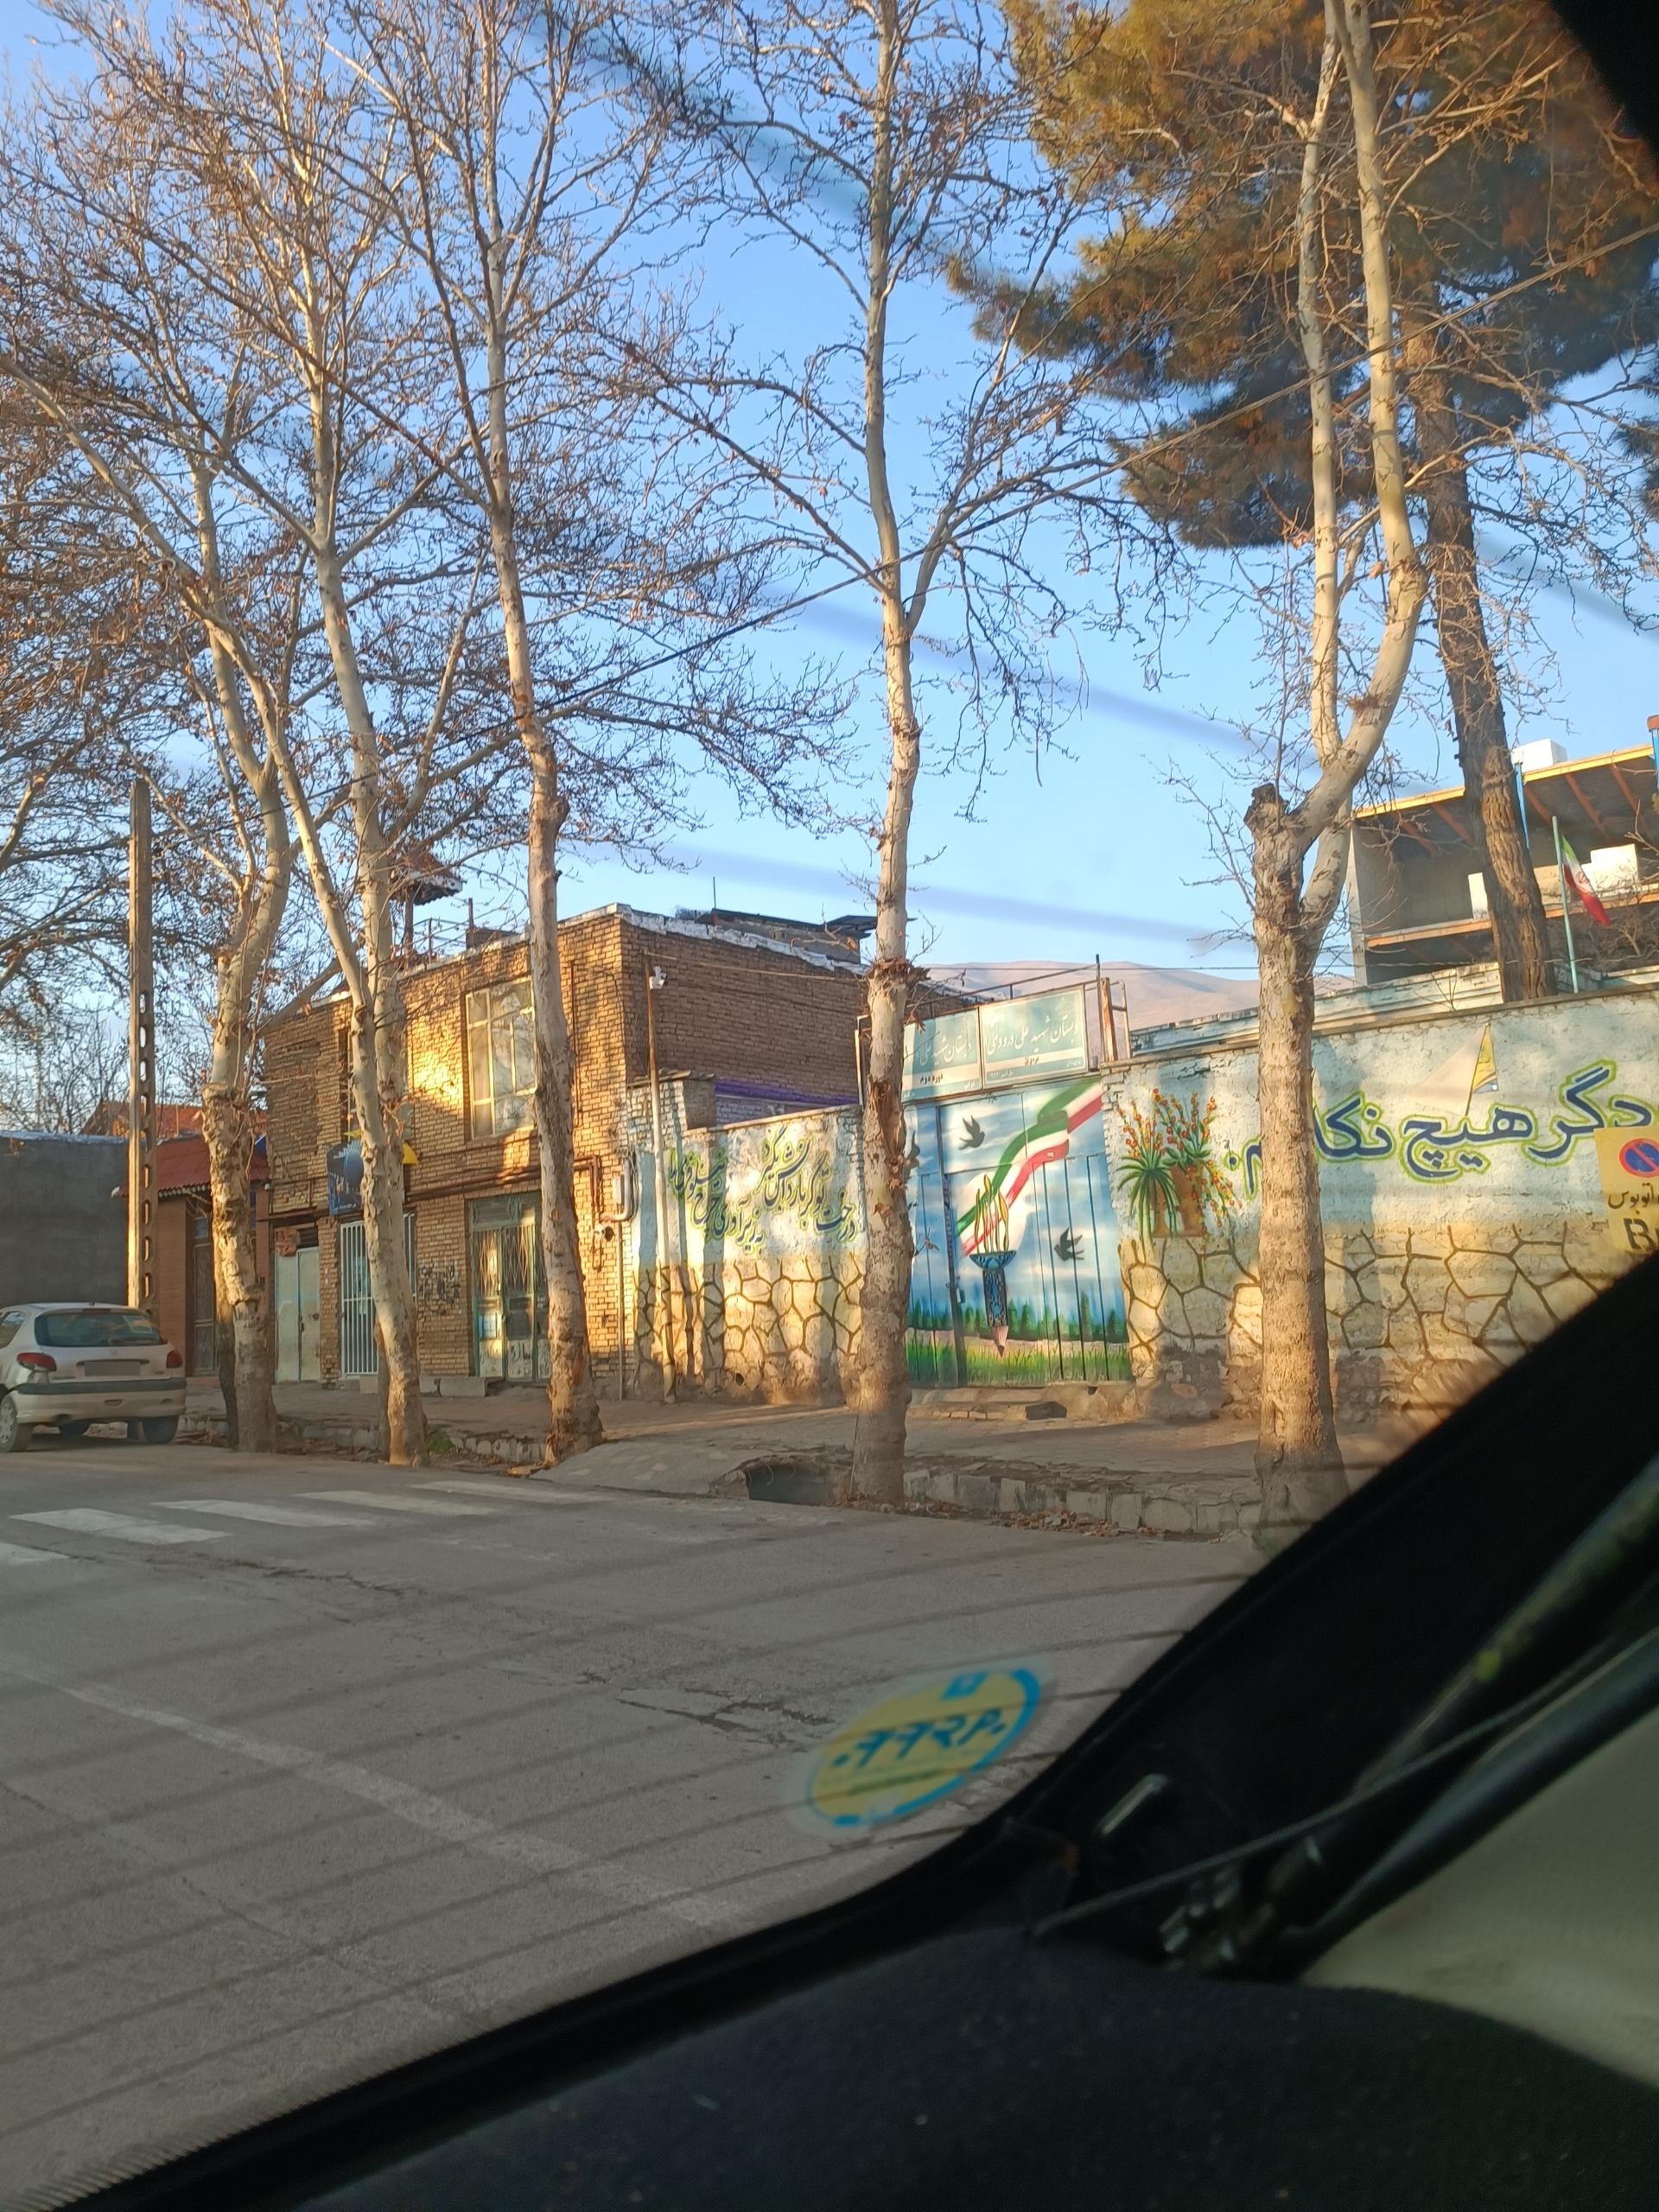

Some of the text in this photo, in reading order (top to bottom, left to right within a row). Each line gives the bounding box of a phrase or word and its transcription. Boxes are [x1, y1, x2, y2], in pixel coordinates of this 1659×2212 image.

[944, 1034, 971, 1063] دبستان
[1030, 1014, 1051, 1053] شهید
[1050, 1014, 1078, 1045] دبستان
[1529, 1066, 1652, 1160] دگر
[1404, 1107, 1534, 1178] هیچ
[813, 1167, 830, 1214] تو
[1608, 1182, 1654, 1214] اتوبوس
[816, 1191, 855, 1239] درخت
